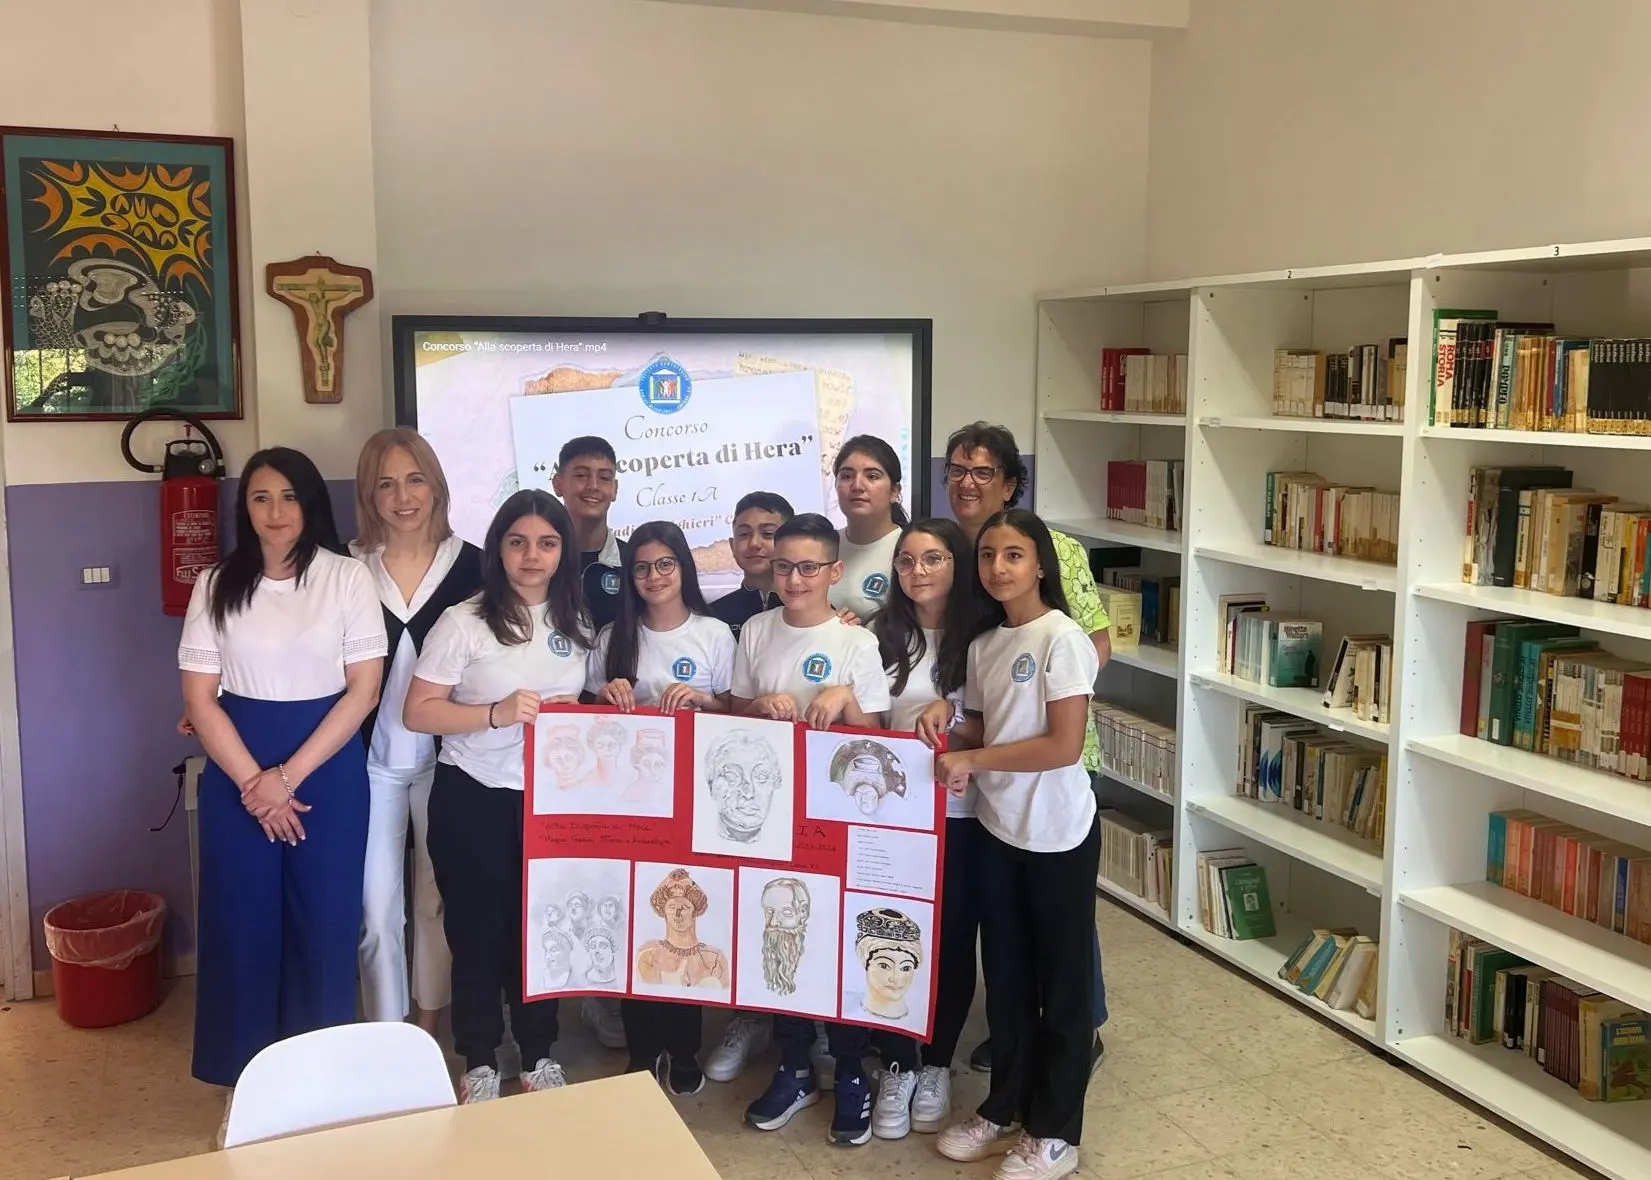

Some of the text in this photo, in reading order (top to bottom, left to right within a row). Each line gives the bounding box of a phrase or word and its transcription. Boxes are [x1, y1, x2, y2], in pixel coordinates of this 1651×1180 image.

[1553, 246, 1560, 256] 3
[1287, 270, 1292, 279] 2
[423, 341, 472, 351] Concorso
[498, 342, 542, 353] scoperta
[544, 342, 553, 351] di
[1437, 344, 1446, 387] STORIA
[1445, 344, 1455, 381] ROMA
[624, 414, 708, 440] Concorso
[615, 434, 813, 477] coperta di Hera”
[636, 483, 686, 507] Classe
